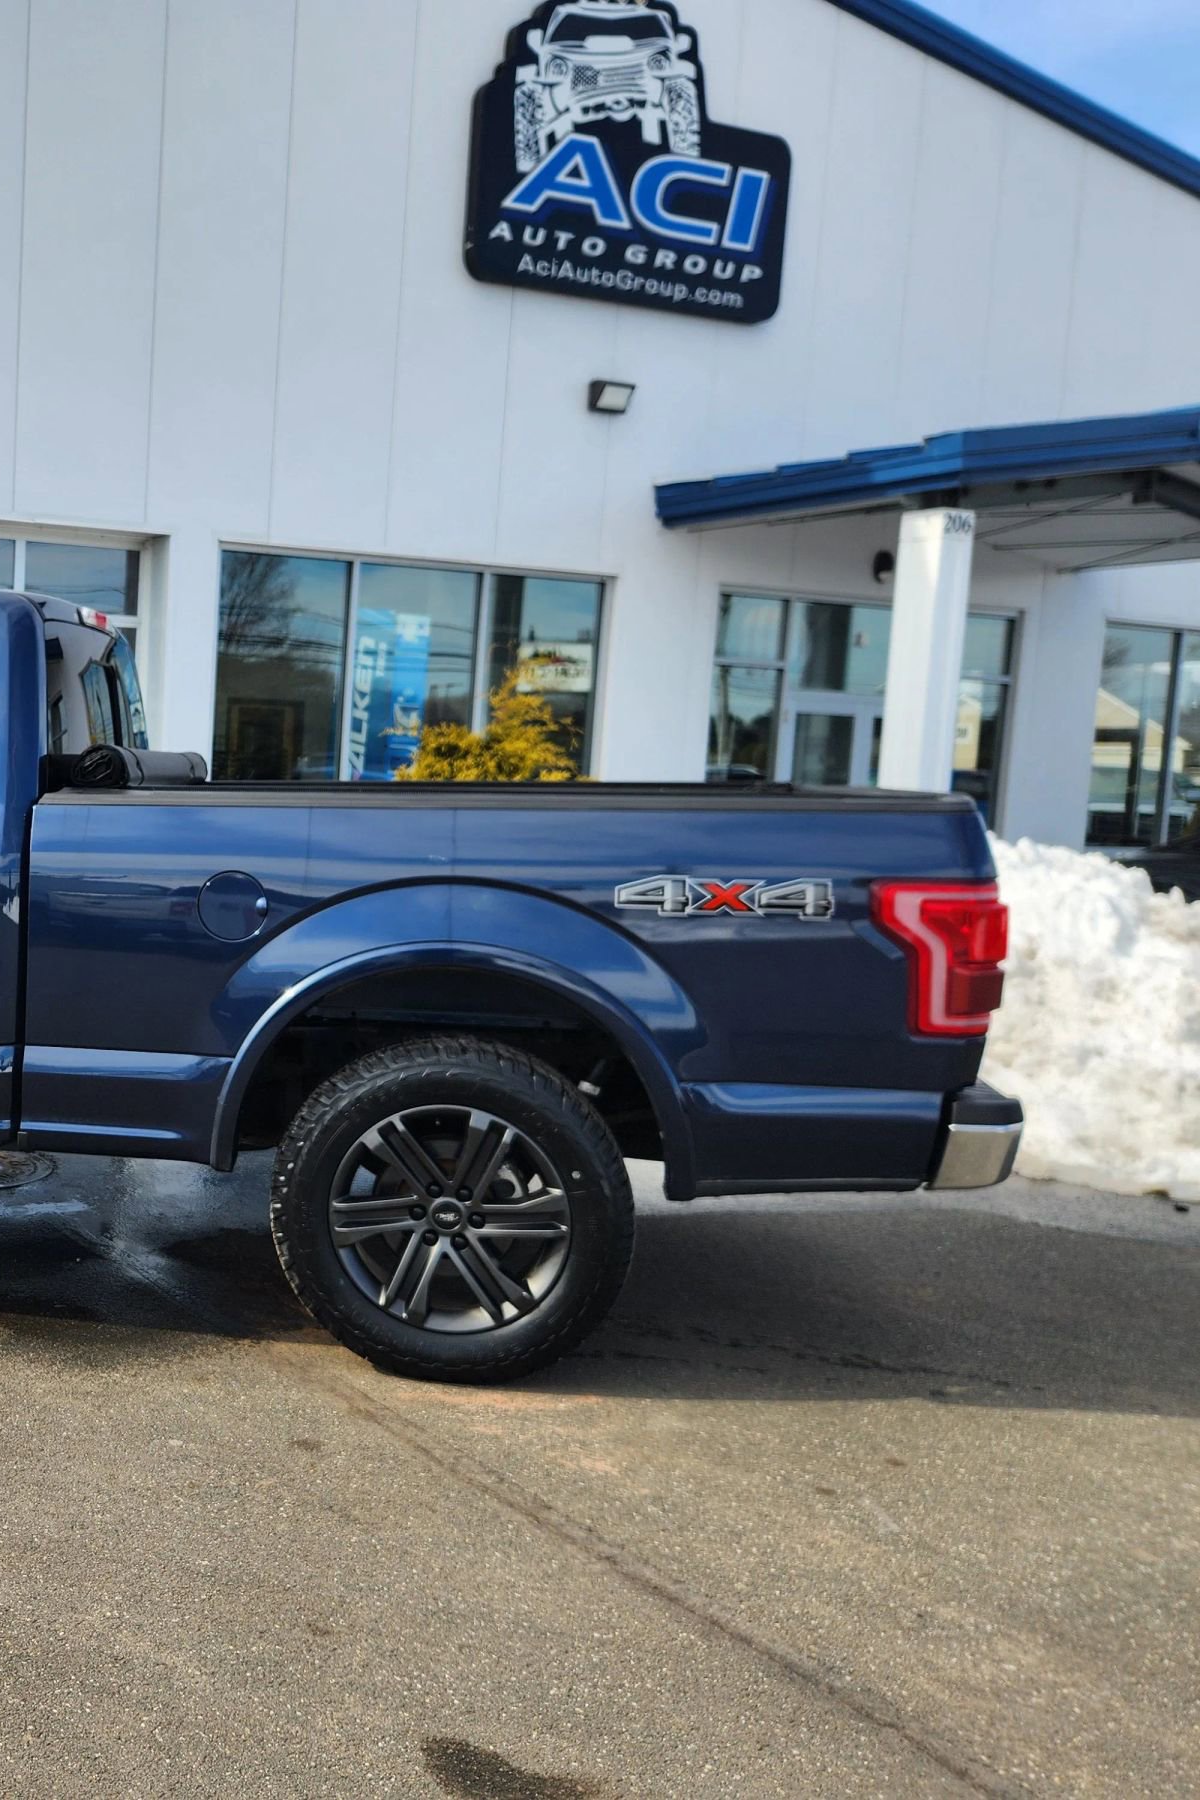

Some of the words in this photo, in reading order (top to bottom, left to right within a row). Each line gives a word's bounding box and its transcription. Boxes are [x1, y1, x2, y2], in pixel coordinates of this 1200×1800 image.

[500, 132, 771, 252] ACI
[488, 221, 607, 258] AUTO
[623, 244, 764, 284] GROUP
[516, 252, 745, 309] AciAutoGroup.com
[943, 511, 973, 536] 206
[347, 635, 376, 775] ALKEN
